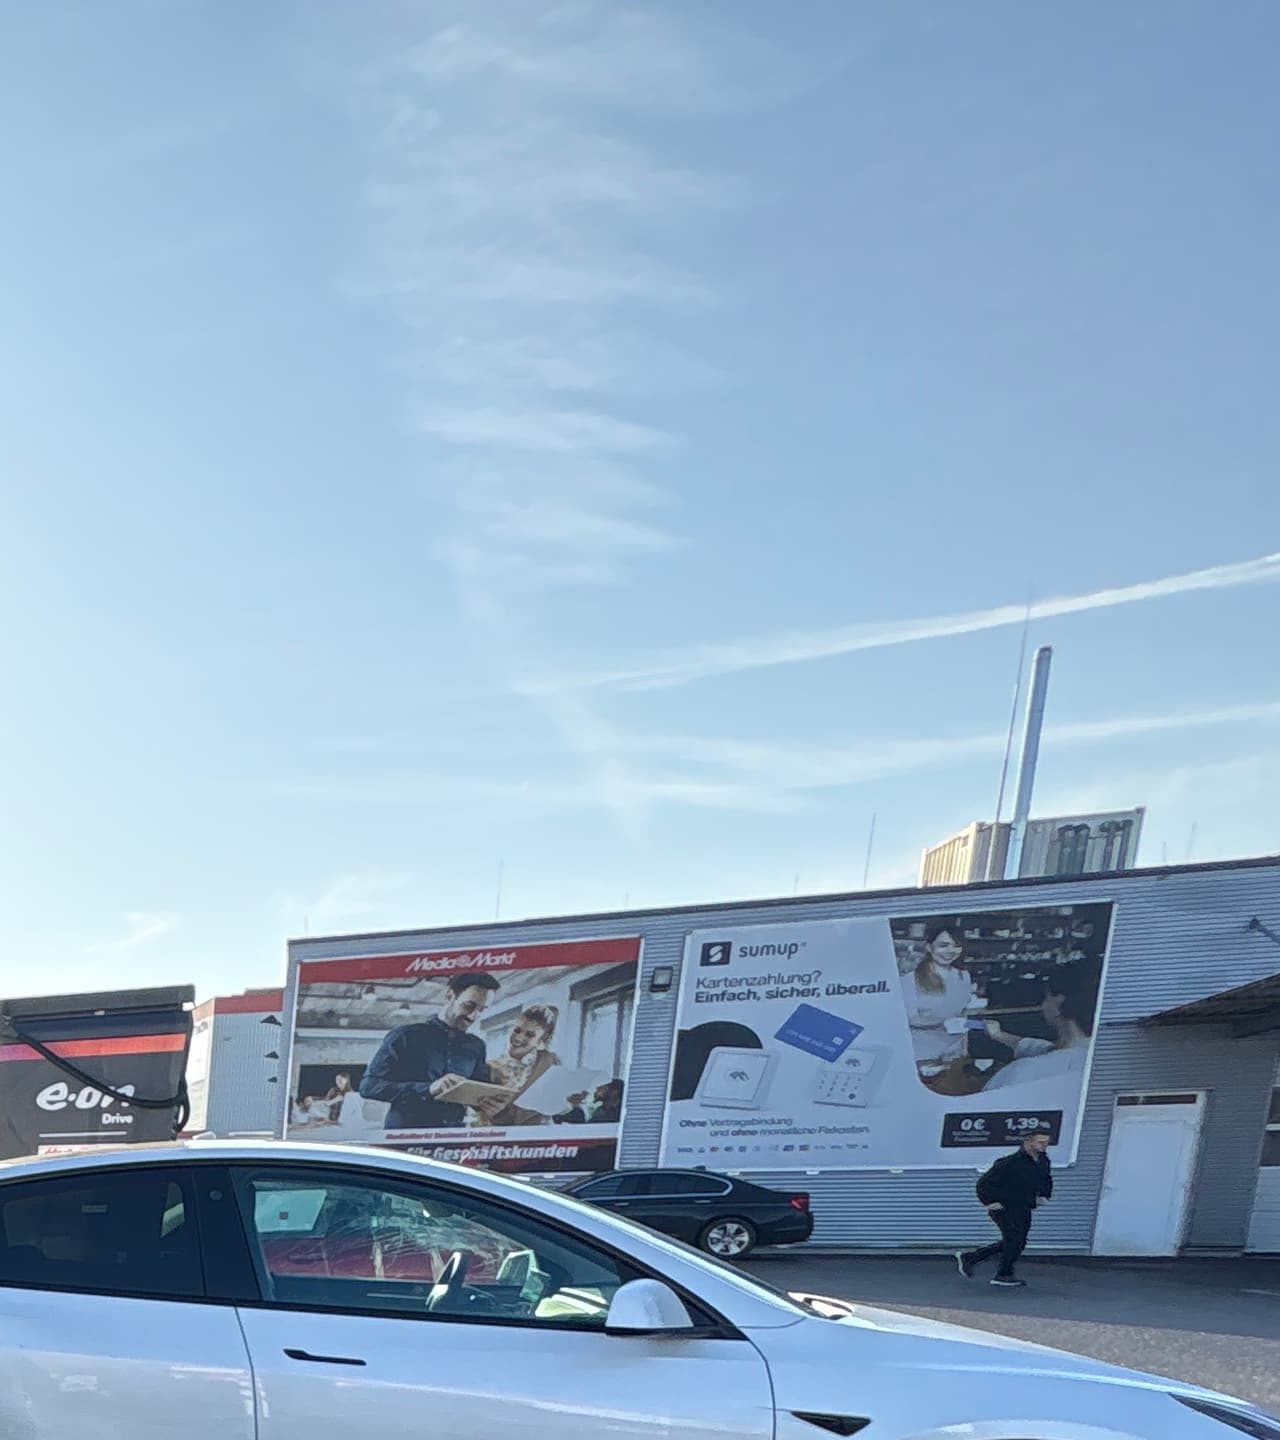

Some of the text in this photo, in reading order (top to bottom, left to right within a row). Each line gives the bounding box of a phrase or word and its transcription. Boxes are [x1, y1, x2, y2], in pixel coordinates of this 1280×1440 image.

[739, 943, 799, 960] sumup
[696, 970, 822, 989] Kartenzahlung?
[695, 981, 890, 1003] Einfach, sicher, überall.
[102, 1113, 133, 1125] Drive
[679, 1119, 706, 1128] Ohne
